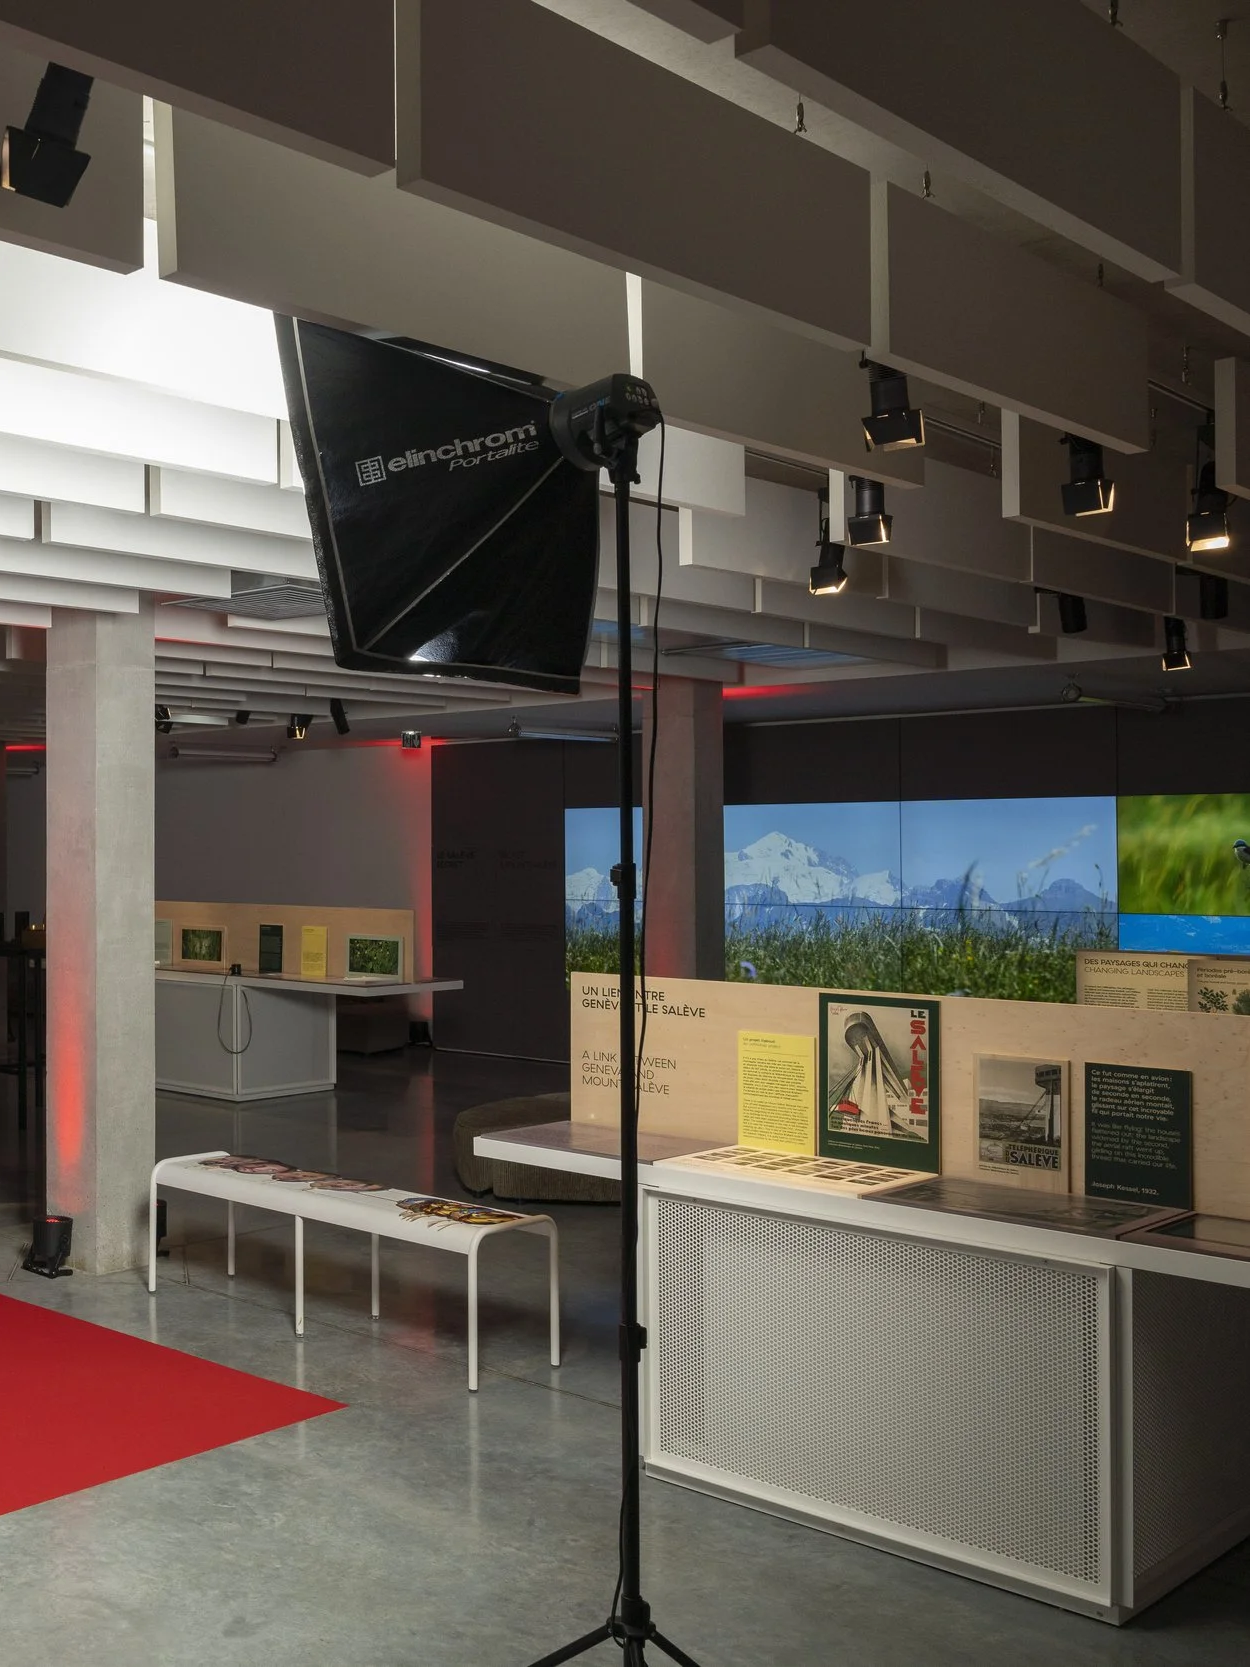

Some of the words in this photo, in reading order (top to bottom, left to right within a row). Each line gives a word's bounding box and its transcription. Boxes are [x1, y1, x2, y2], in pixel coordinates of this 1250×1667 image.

[388, 424, 537, 472] elinchrom
[449, 440, 539, 471] Portalite
[1084, 966, 1128, 975] CHANGING
[1131, 969, 1184, 977] LANDSCAPES
[582, 986, 598, 996] UN
[636, 990, 664, 1001] NTRE
[582, 998, 619, 1010] GENÈV
[646, 1004, 658, 1014] LE
[662, 1004, 706, 1018] SALÈVE
[910, 1010, 926, 1018] LE
[582, 1050, 590, 1060] A
[594, 1052, 617, 1063] LINK
[635, 1056, 676, 1069] TWEEN
[635, 1070, 654, 1080] ND
[635, 1081, 670, 1095] ALÈVE
